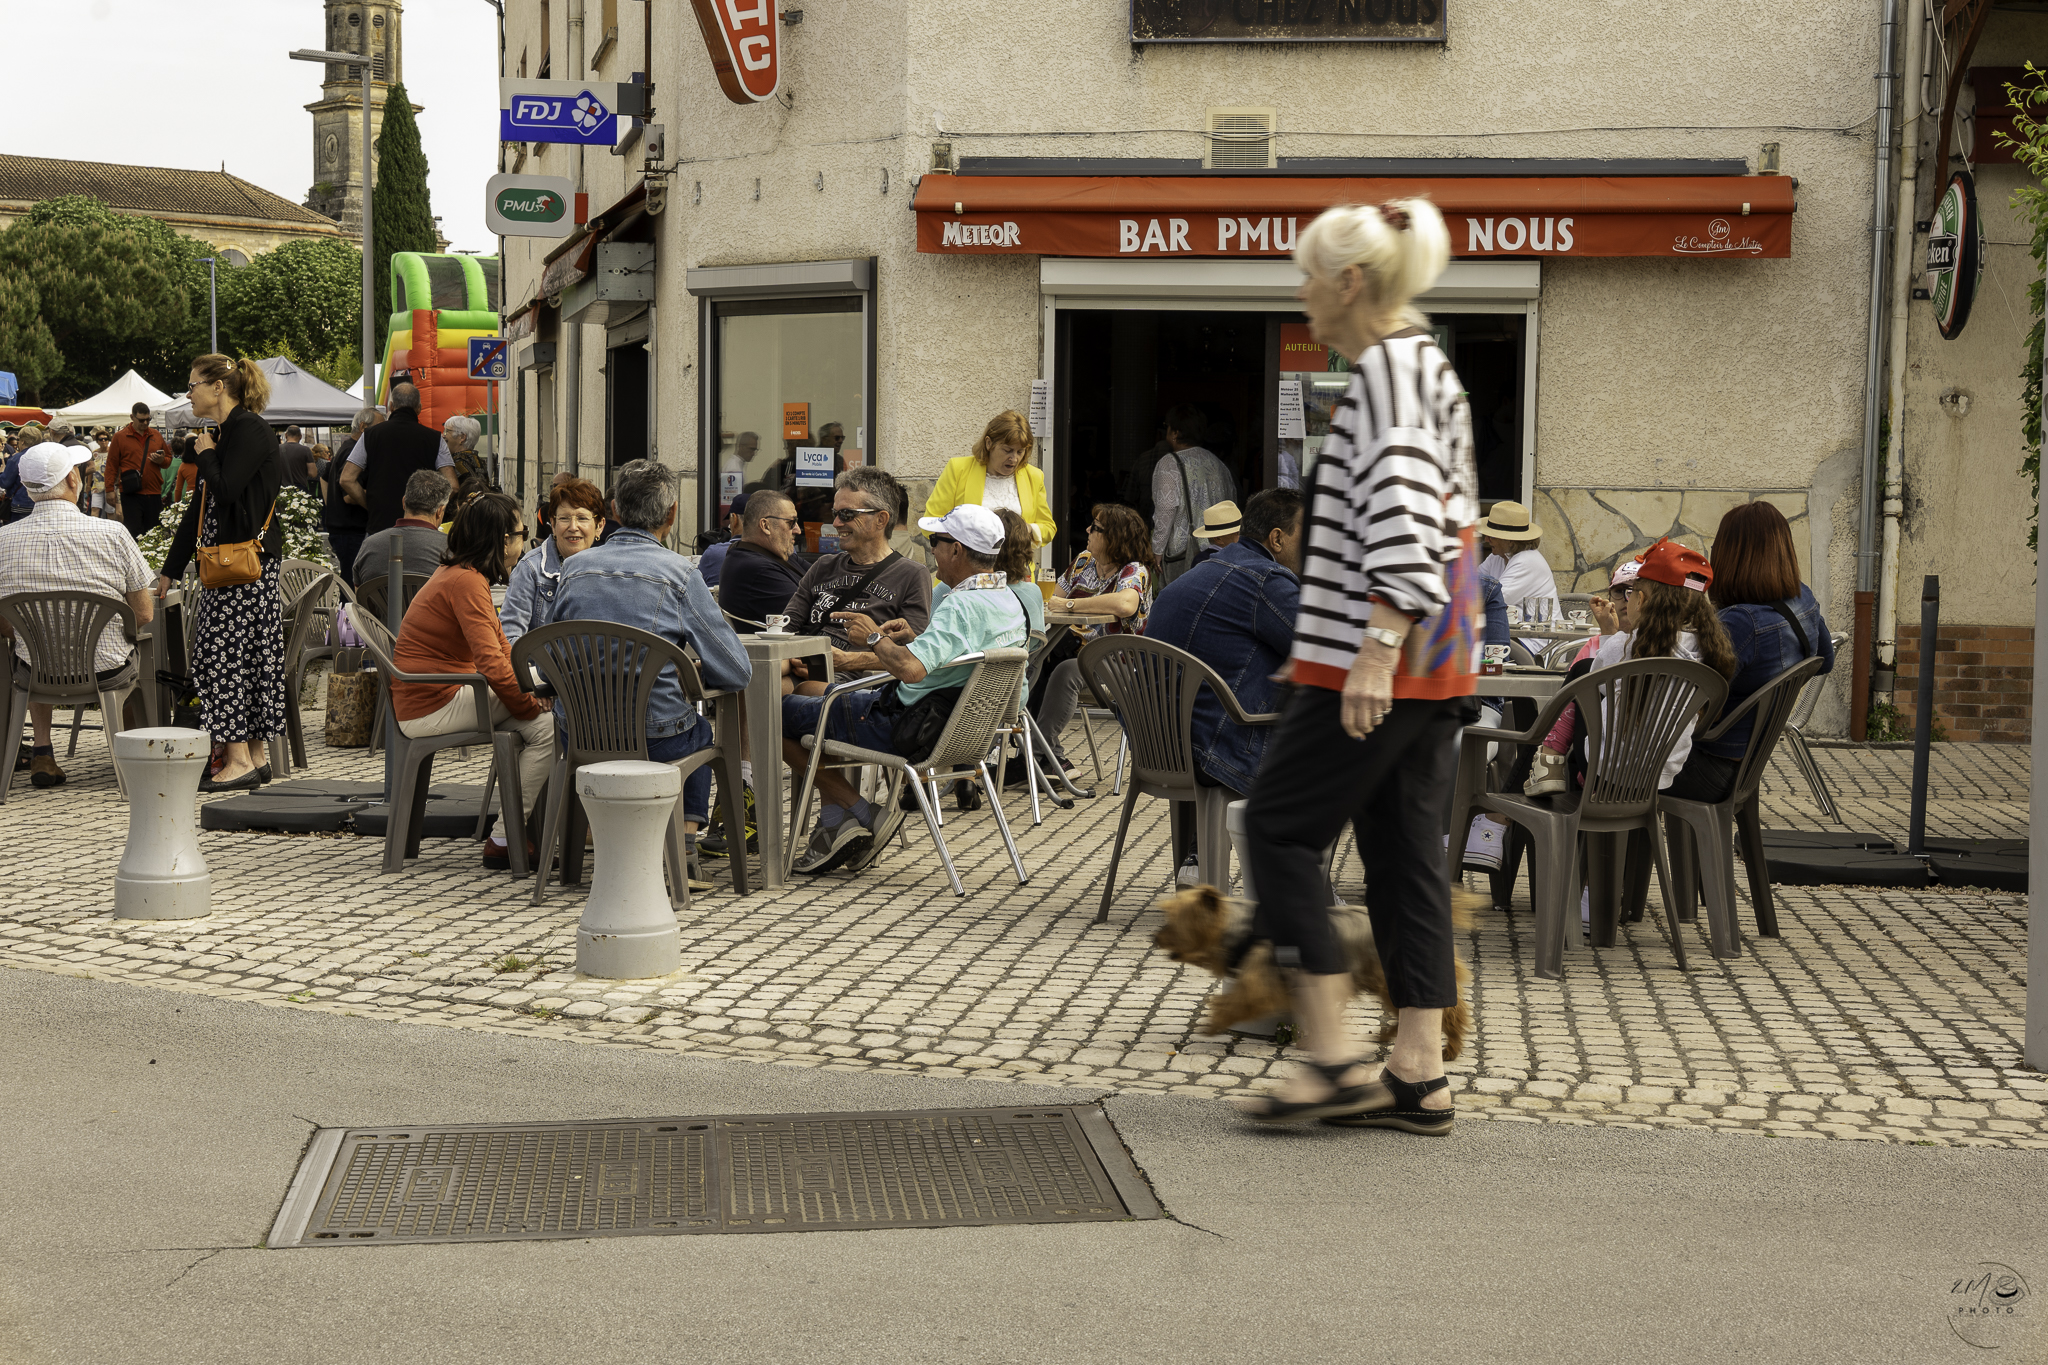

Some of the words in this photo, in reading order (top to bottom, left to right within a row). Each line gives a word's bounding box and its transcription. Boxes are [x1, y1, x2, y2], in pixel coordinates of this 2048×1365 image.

[516, 100, 562, 121] FDJ
[503, 199, 535, 212] PMU
[942, 221, 1021, 248] METEOR
[1119, 218, 1192, 253] BAR
[1217, 217, 1297, 251] PMU
[1466, 217, 1574, 252] NOUS
[1674, 235, 1688, 249] Le
[1724, 238, 1733, 249] de
[1284, 343, 1322, 352] AUTEUIL
[804, 451, 822, 463] Lyca
